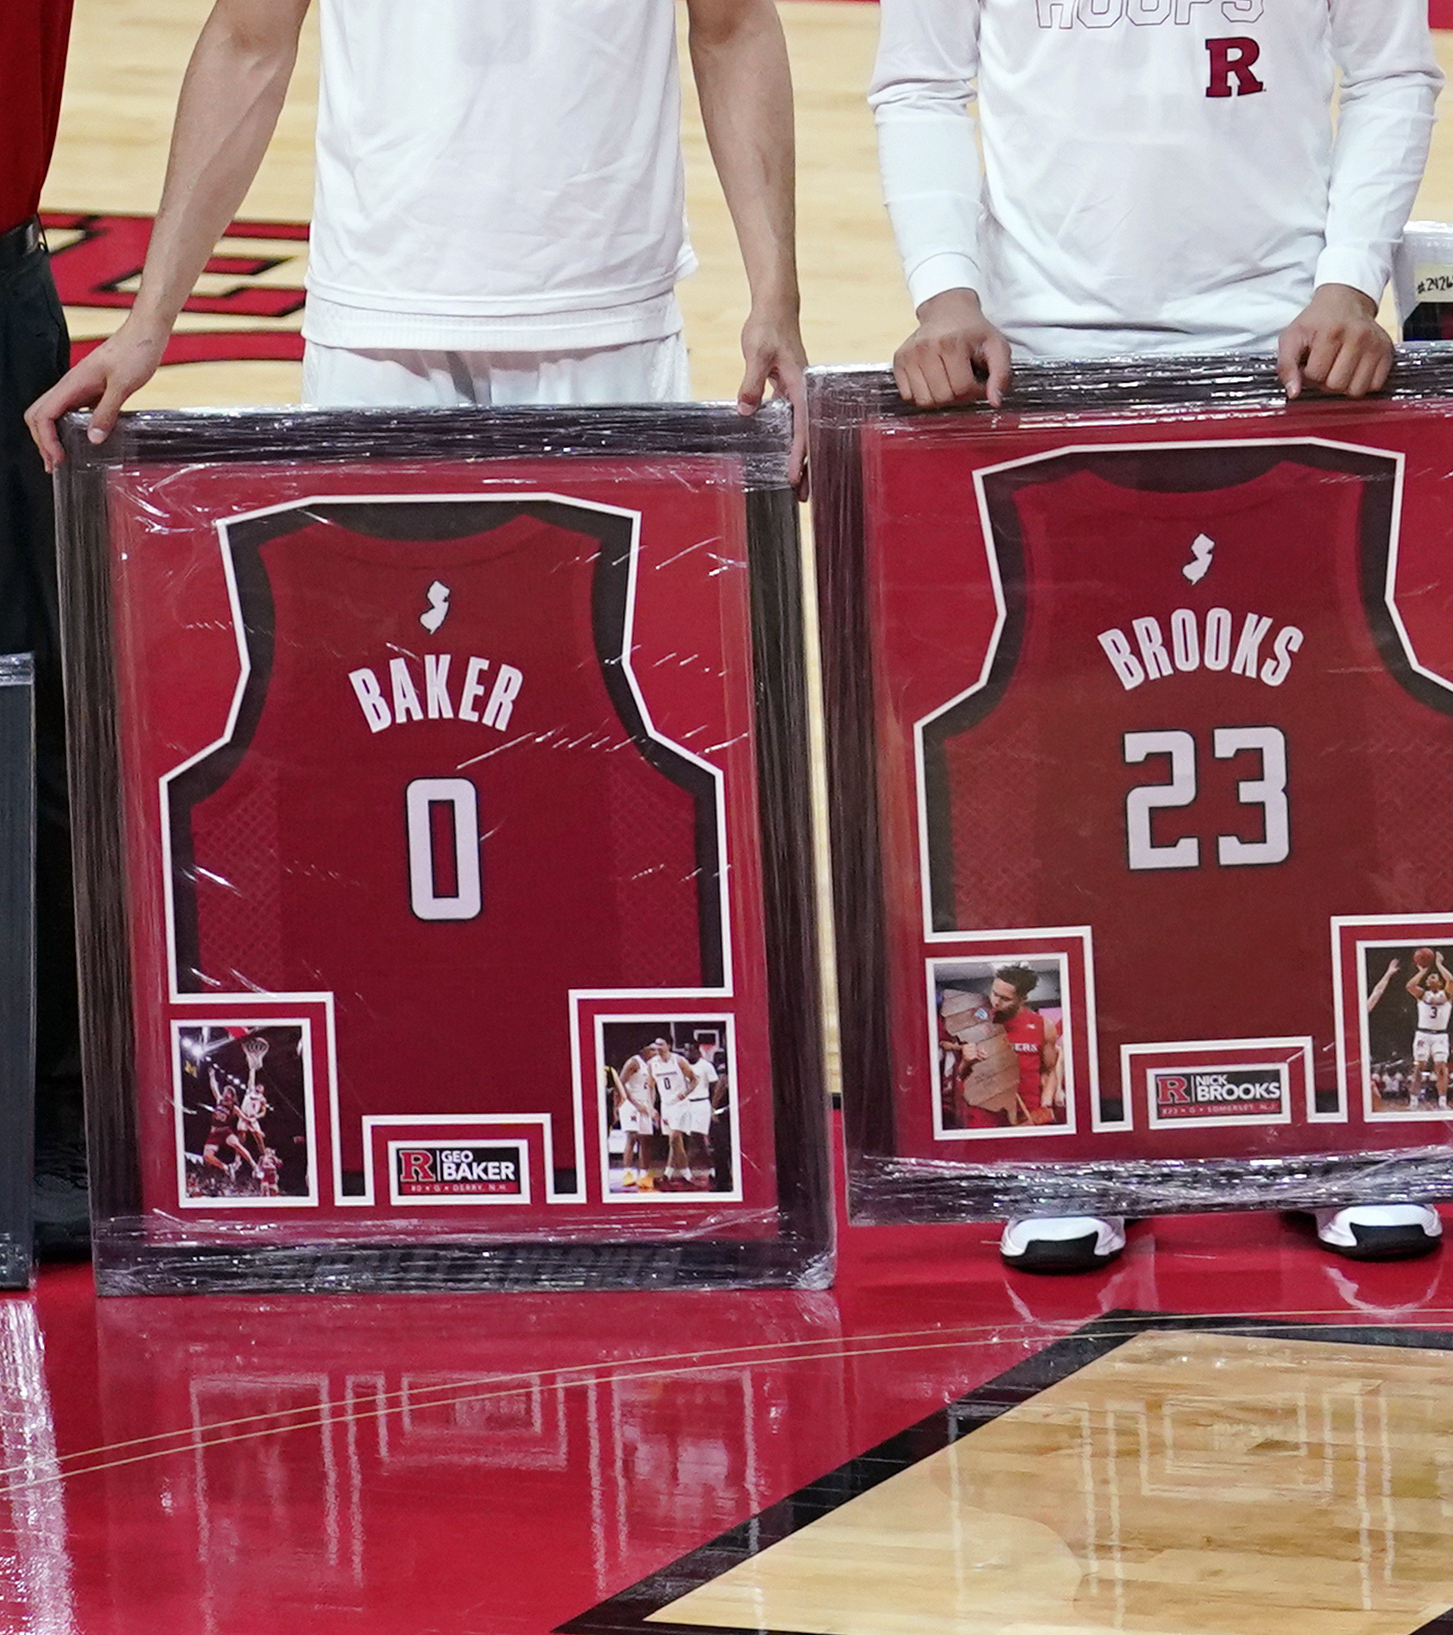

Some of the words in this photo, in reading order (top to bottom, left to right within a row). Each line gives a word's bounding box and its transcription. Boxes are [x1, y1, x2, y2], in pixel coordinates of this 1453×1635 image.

[1205, 37, 1264, 98] R
[1098, 606, 1304, 691] BROOKS
[349, 653, 523, 734] BAKER
[1122, 724, 1292, 871] 23
[405, 776, 482, 921] 0
[1157, 1076, 1190, 1104] R
[1196, 1074, 1228, 1086] NICK
[1197, 1082, 1280, 1101] BROOKS
[399, 1150, 436, 1182] R
[441, 1150, 473, 1163] GEO
[443, 1161, 515, 1181] BAKER
